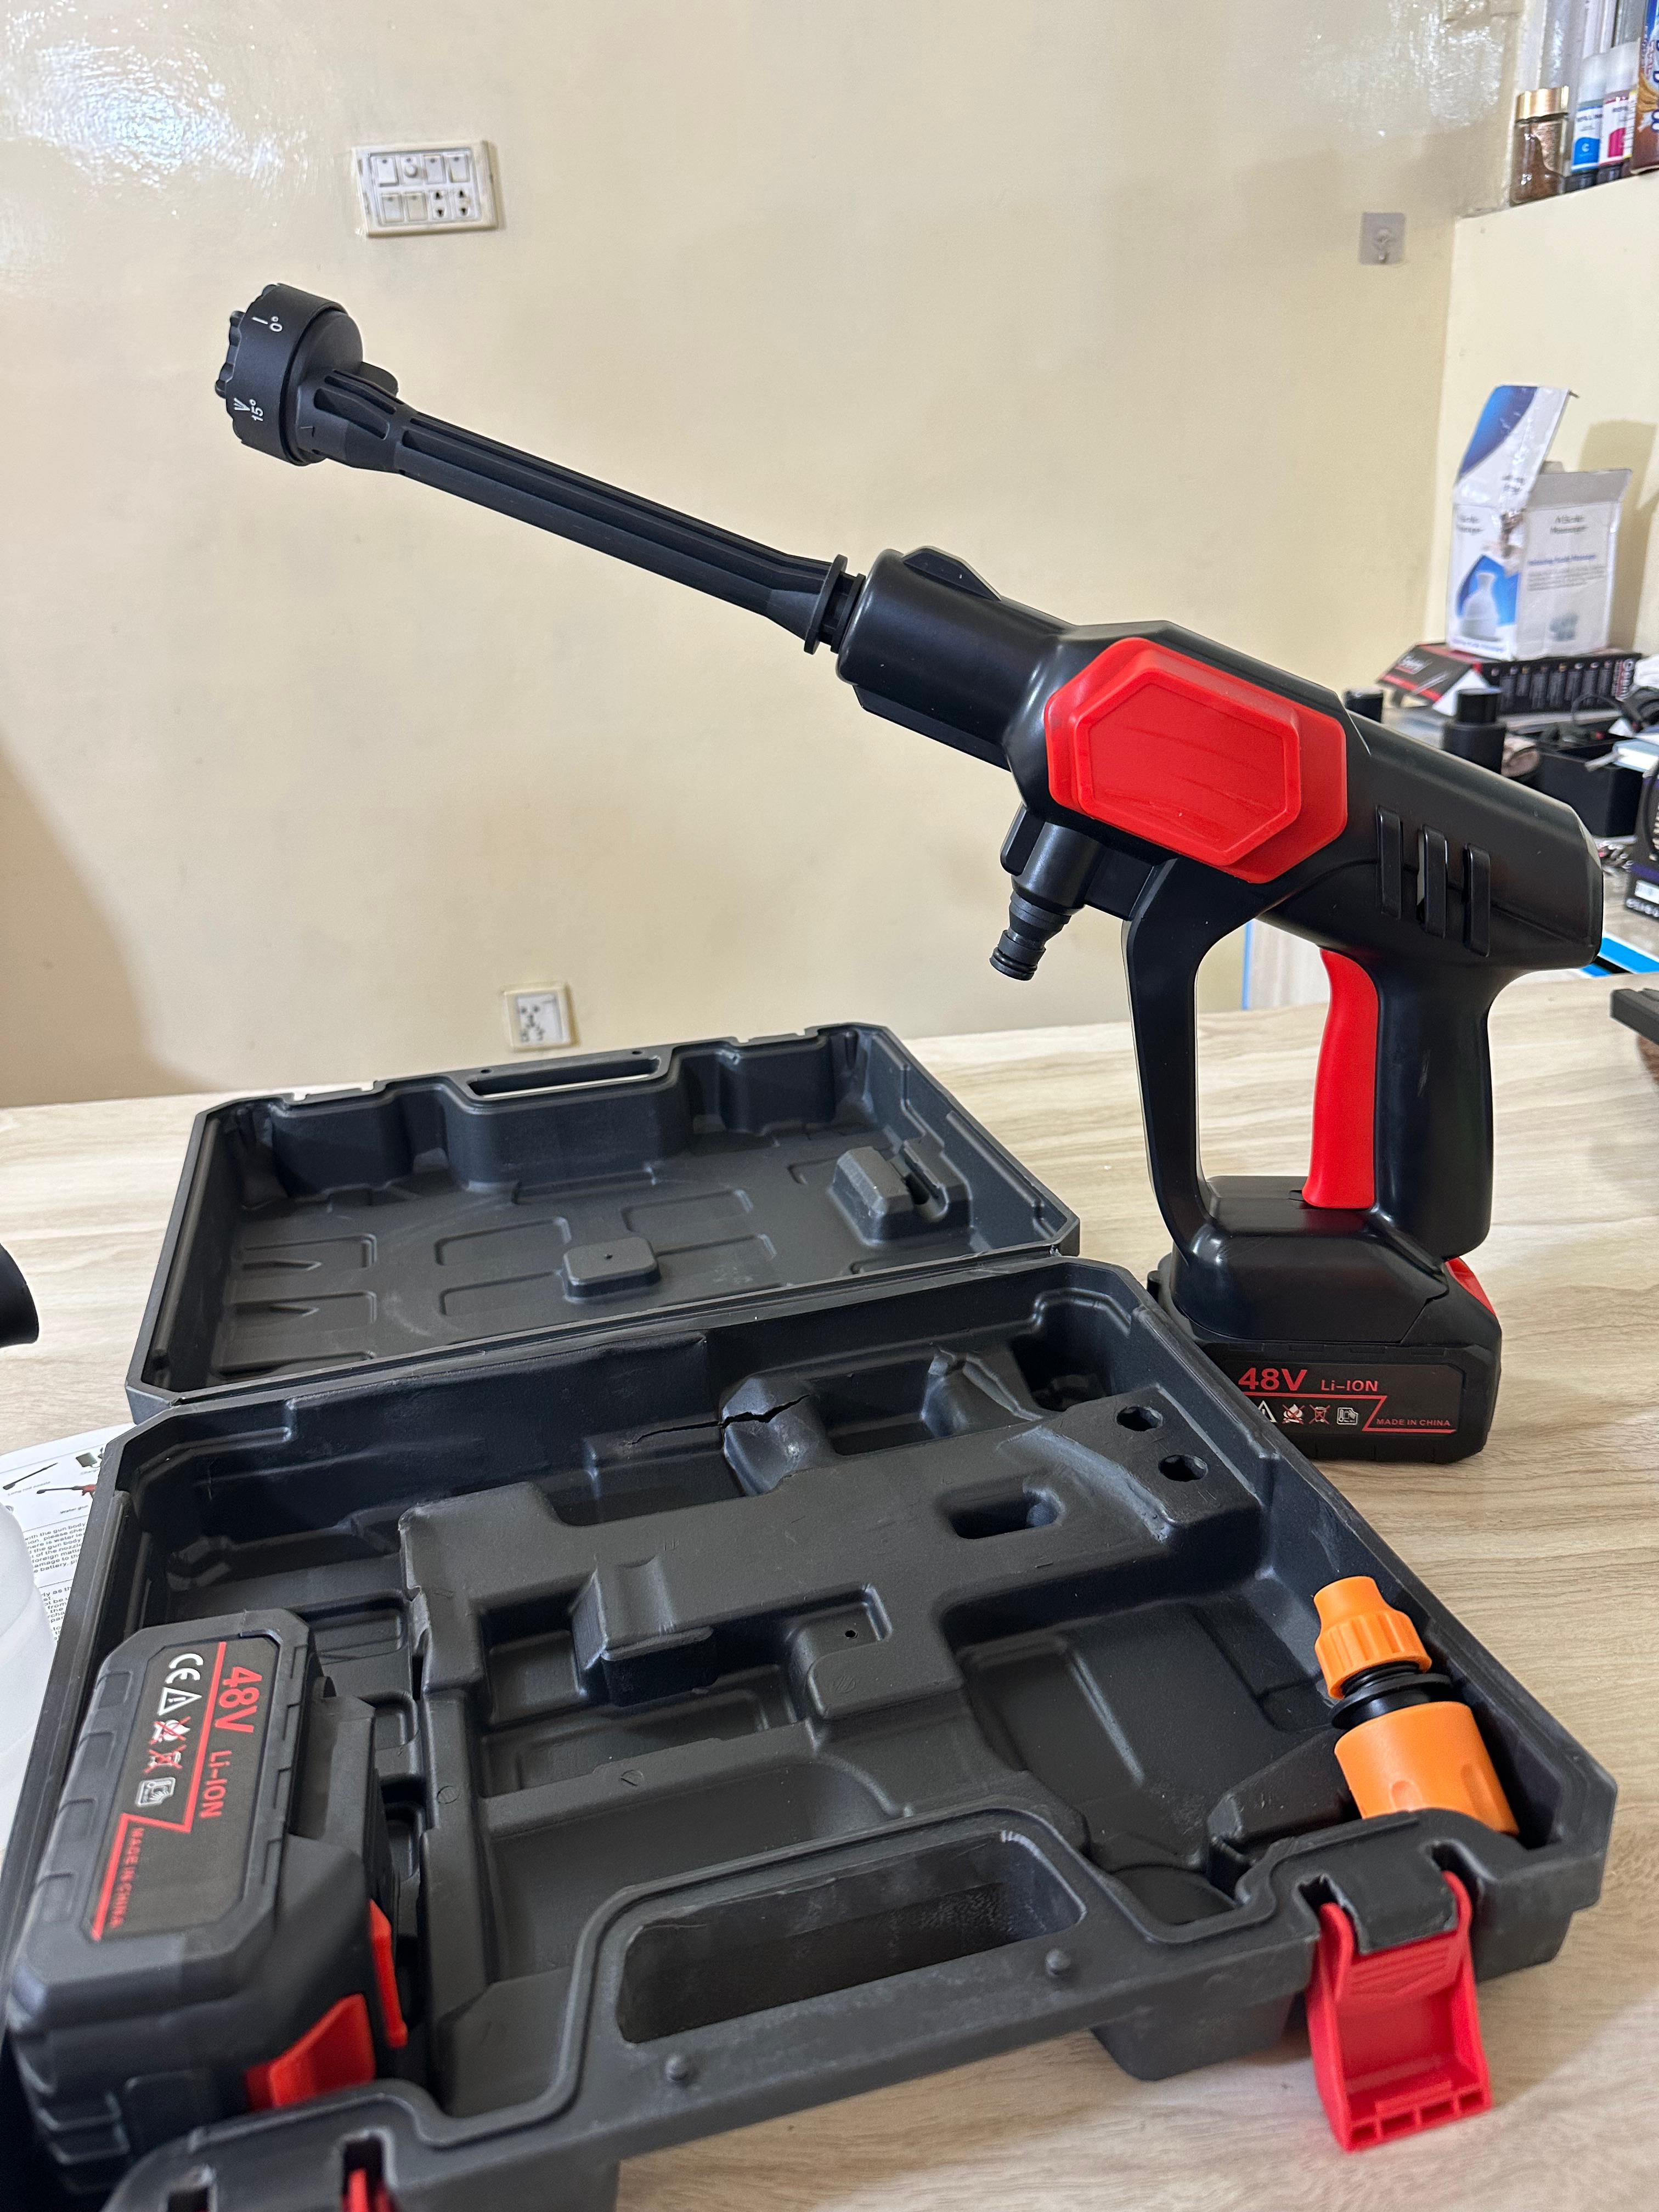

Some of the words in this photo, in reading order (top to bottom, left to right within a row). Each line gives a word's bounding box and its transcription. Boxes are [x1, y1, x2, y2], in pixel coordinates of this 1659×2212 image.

[1238, 1367, 1308, 1391] 48V
[1321, 1379, 1378, 1392] Li-ION
[43, 1532, 68, 1541] please
[54, 1534, 74, 1543] water
[47, 1601, 67, 1610] from
[215, 1666, 263, 1733] 48V
[199, 1750, 233, 1819] Li-ION
